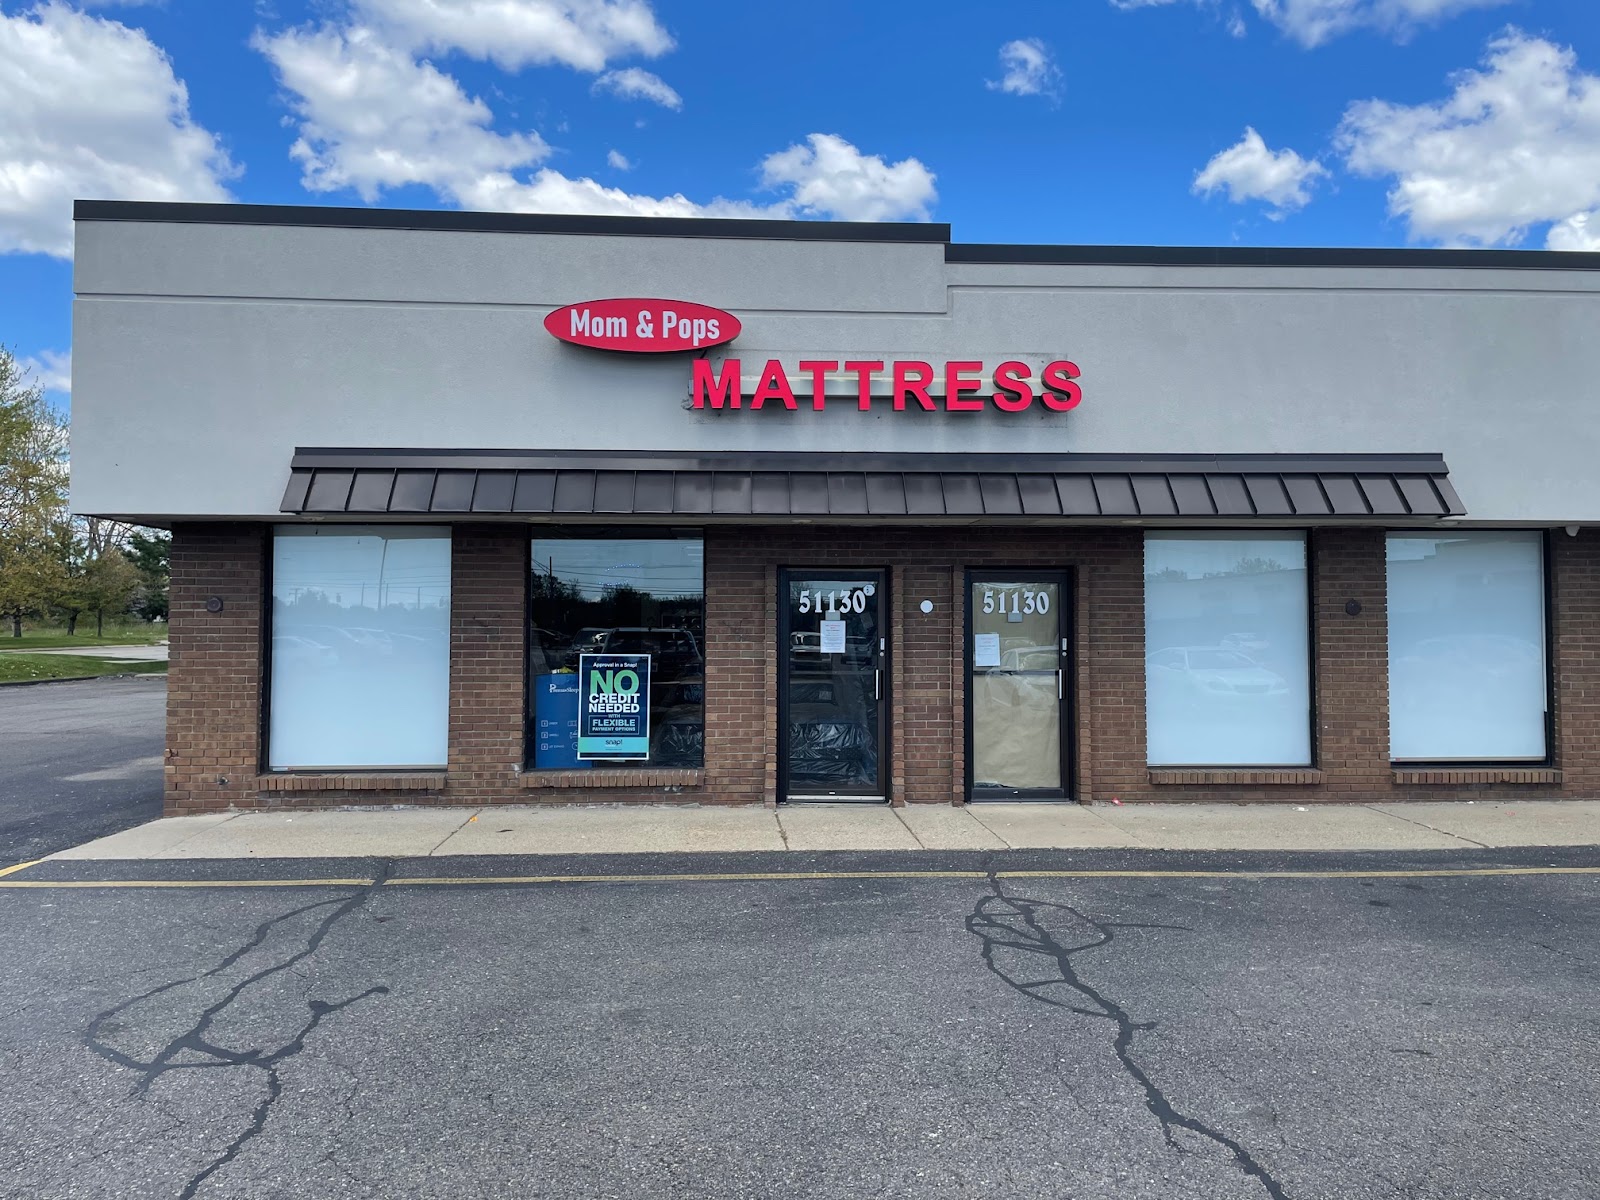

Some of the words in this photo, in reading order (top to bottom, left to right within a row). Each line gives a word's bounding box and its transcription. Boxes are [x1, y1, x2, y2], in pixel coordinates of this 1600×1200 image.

[570, 309, 627, 337] Mom
[635, 310, 654, 339] &
[662, 311, 720, 346] Pops
[692, 359, 1082, 412] MATTRESS
[799, 590, 866, 614] 51130
[983, 590, 1049, 615] 51130
[590, 669, 639, 696] NO
[588, 703, 640, 713] NEEDED
[589, 693, 640, 703] CREDIT
[592, 719, 636, 727] FLEXIBLE
